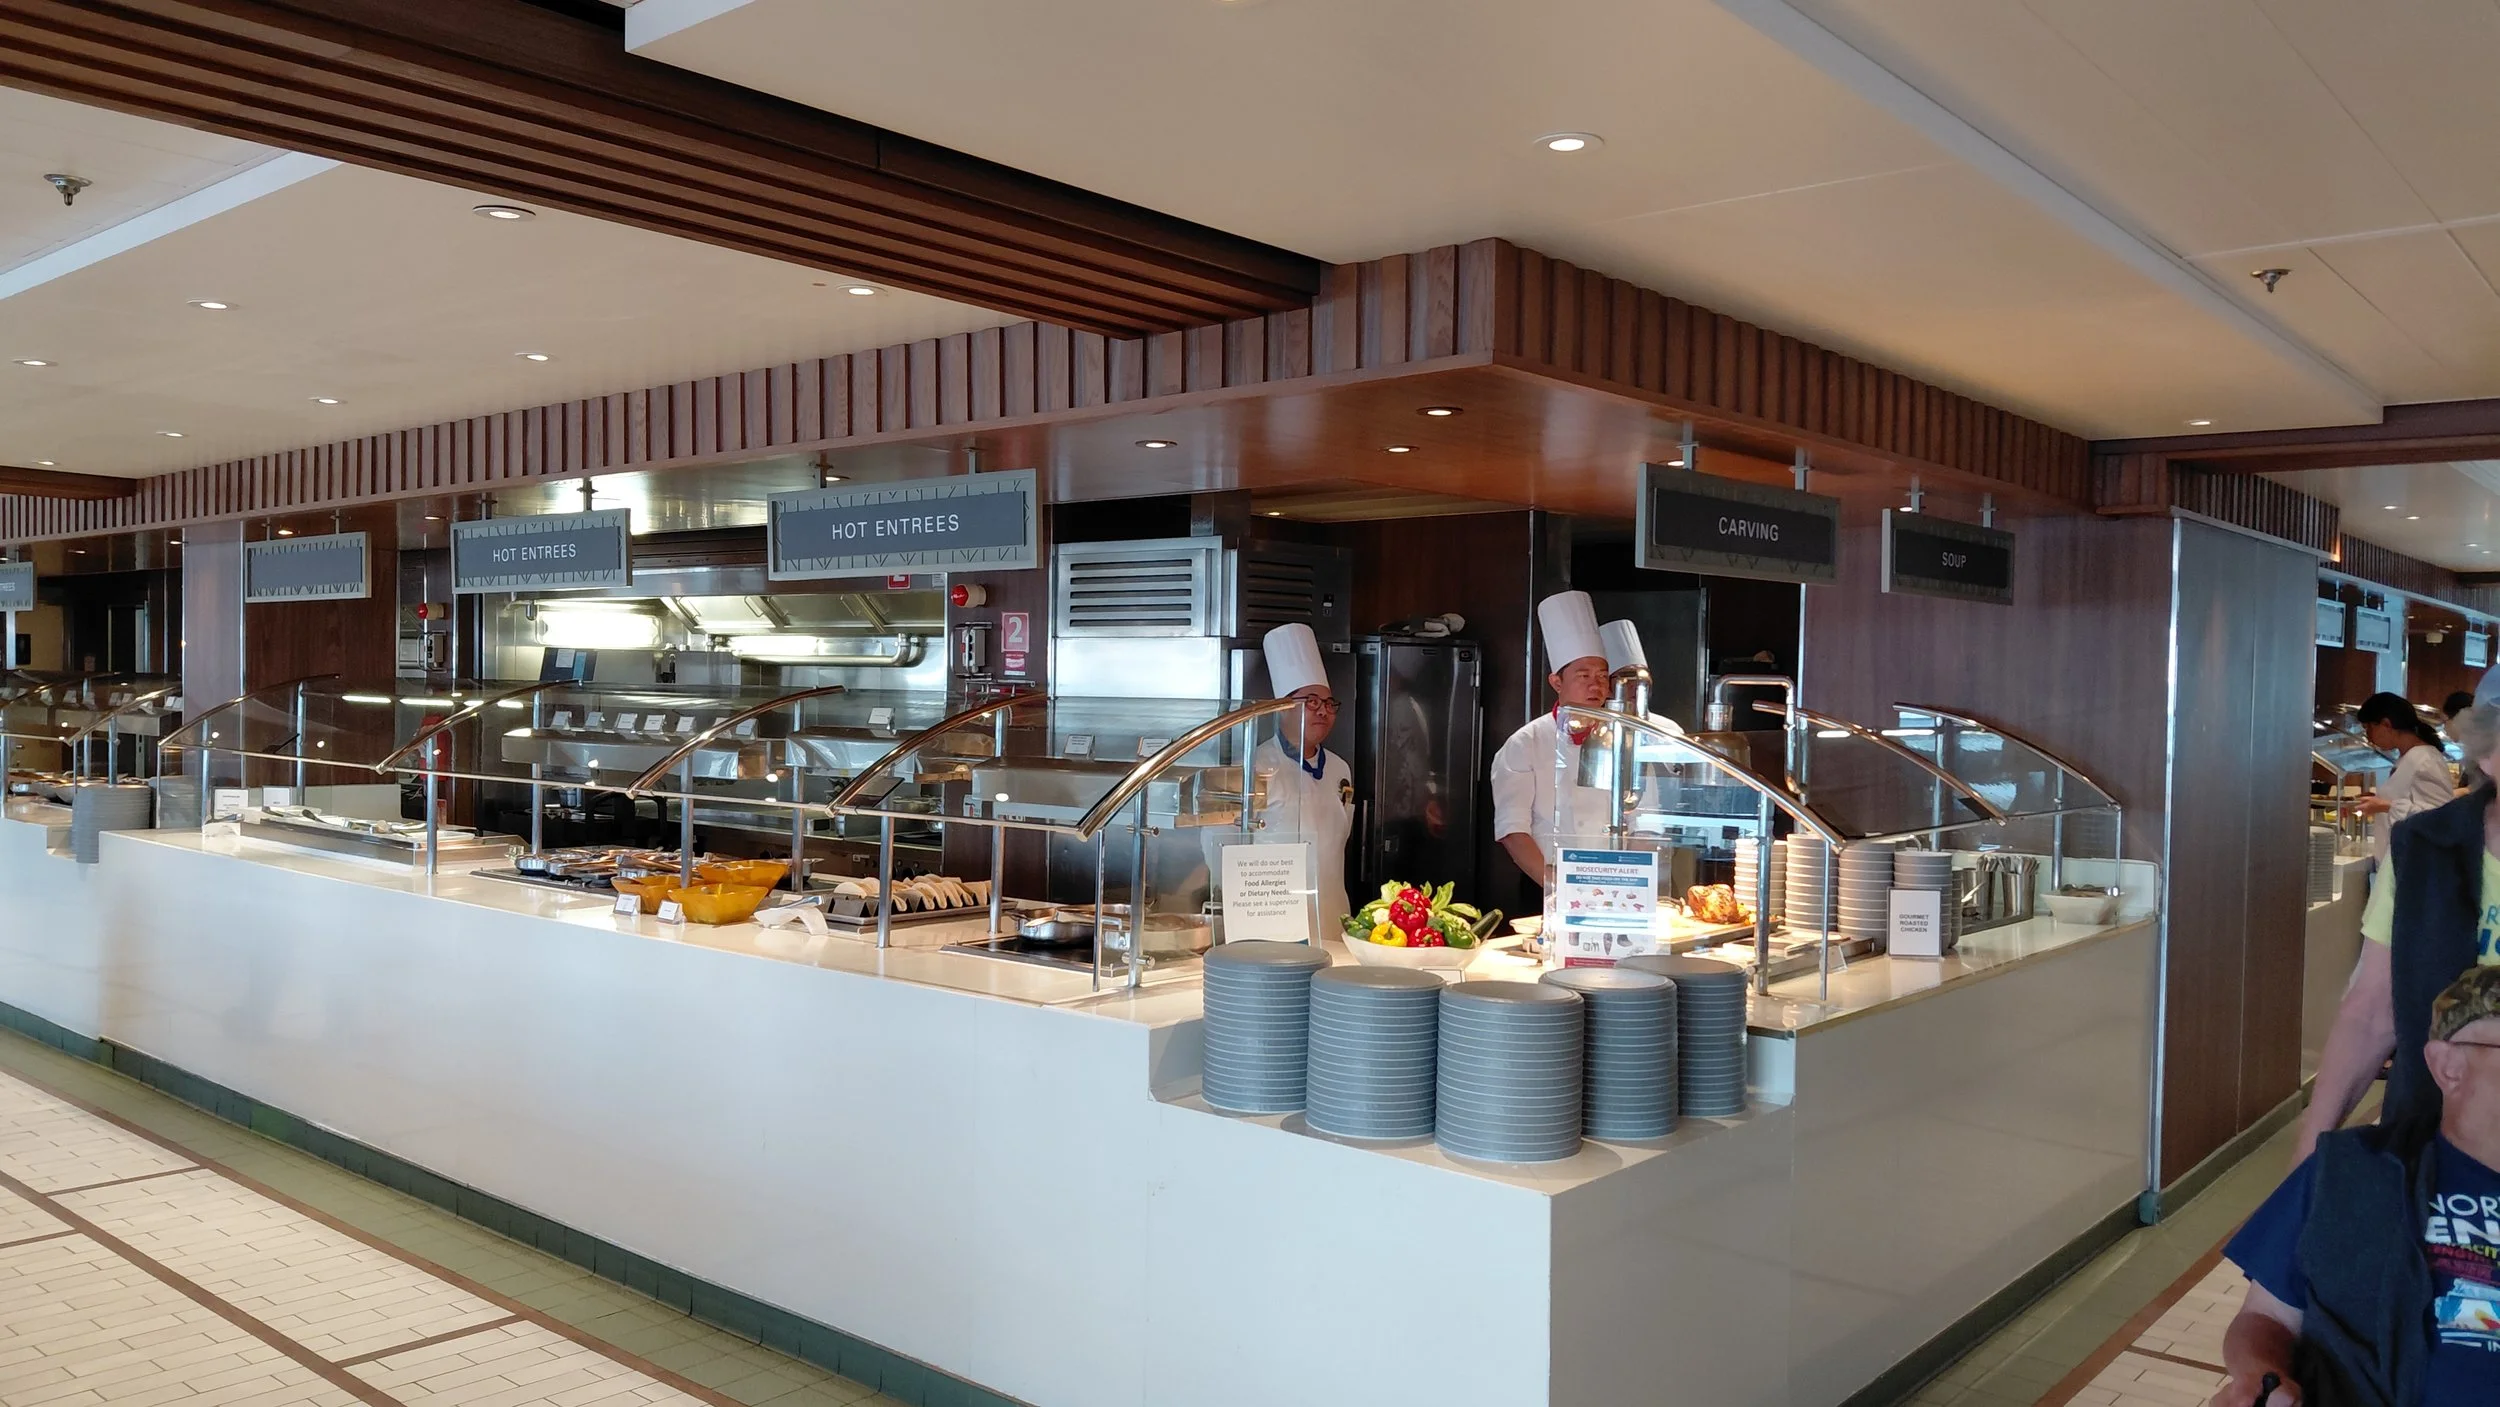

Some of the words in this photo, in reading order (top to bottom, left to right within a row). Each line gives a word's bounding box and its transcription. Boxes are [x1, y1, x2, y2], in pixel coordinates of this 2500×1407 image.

[832, 521, 868, 540] HOT
[875, 514, 959, 537] ENTREES
[1718, 516, 1779, 541] CARVING
[493, 548, 517, 562] HOT
[521, 543, 577, 561] ENTREES
[1942, 551, 1967, 568] SOUP
[1008, 616, 1023, 643] 2
[1248, 869, 1290, 877] accommodate
[1576, 866, 1618, 875] BIOSECURITY
[1618, 867, 1639, 875] ALERT
[1248, 890, 1270, 898] Dietary
[1269, 898, 1299, 907] supervisor
[2428, 1192, 2500, 1220] NOR
